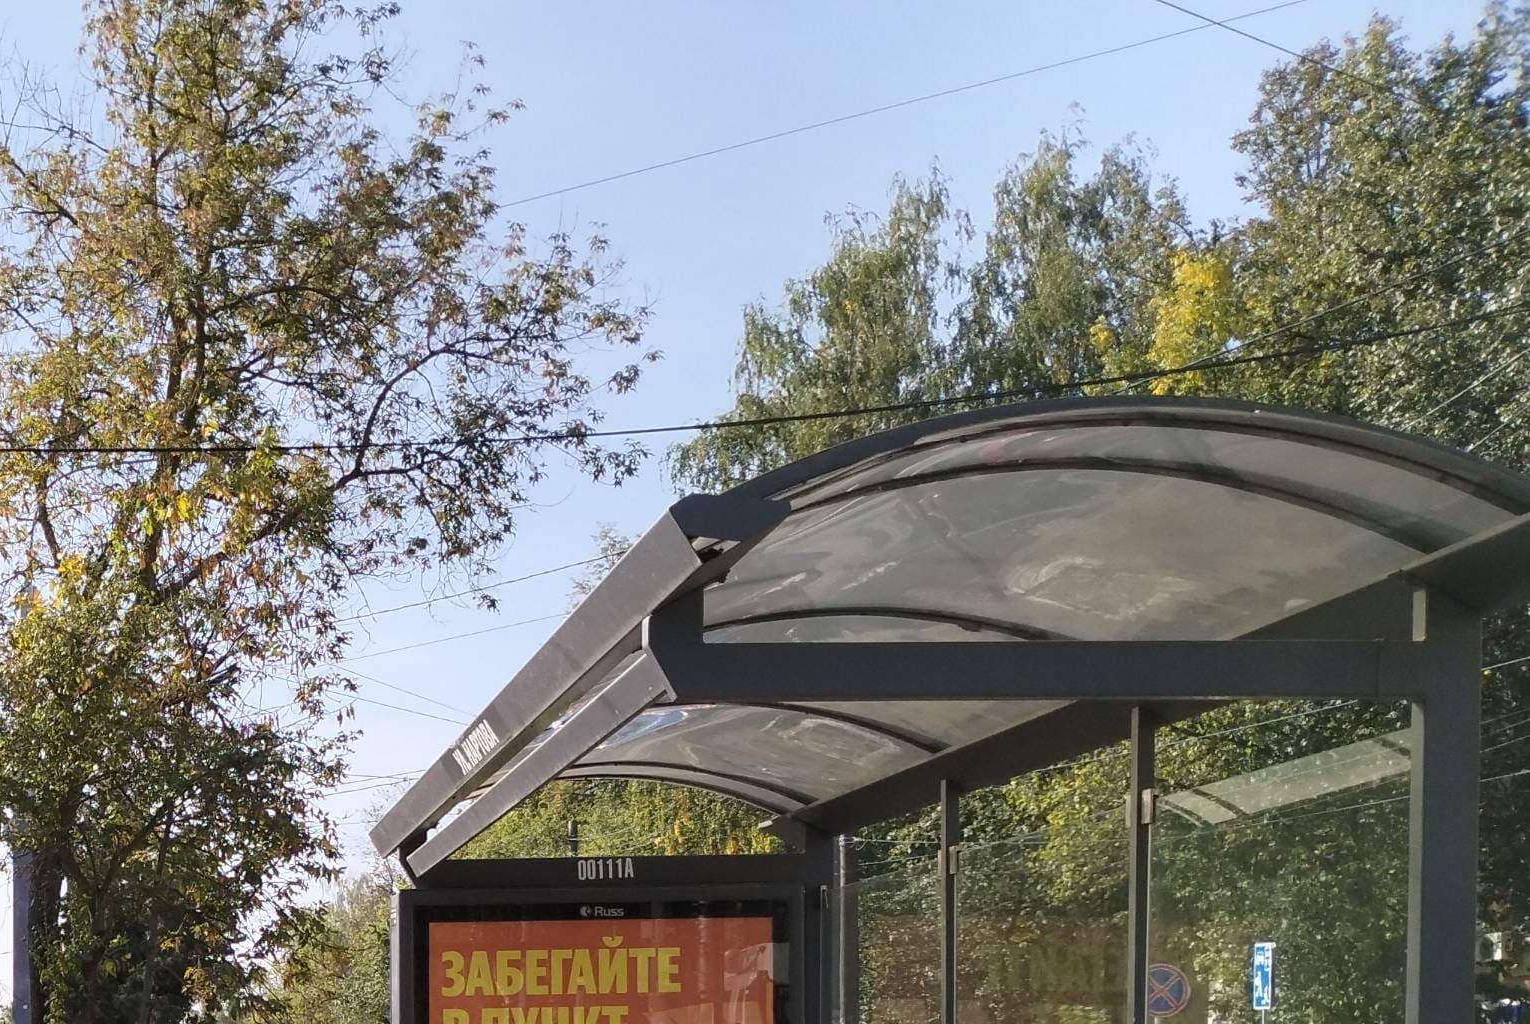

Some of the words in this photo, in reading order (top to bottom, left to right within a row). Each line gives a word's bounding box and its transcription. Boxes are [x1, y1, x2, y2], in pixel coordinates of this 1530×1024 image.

[461, 719, 500, 767] НАРТОВА
[594, 906, 624, 917] Russ
[441, 935, 682, 997] ЗАБЕГАЙТЕ
